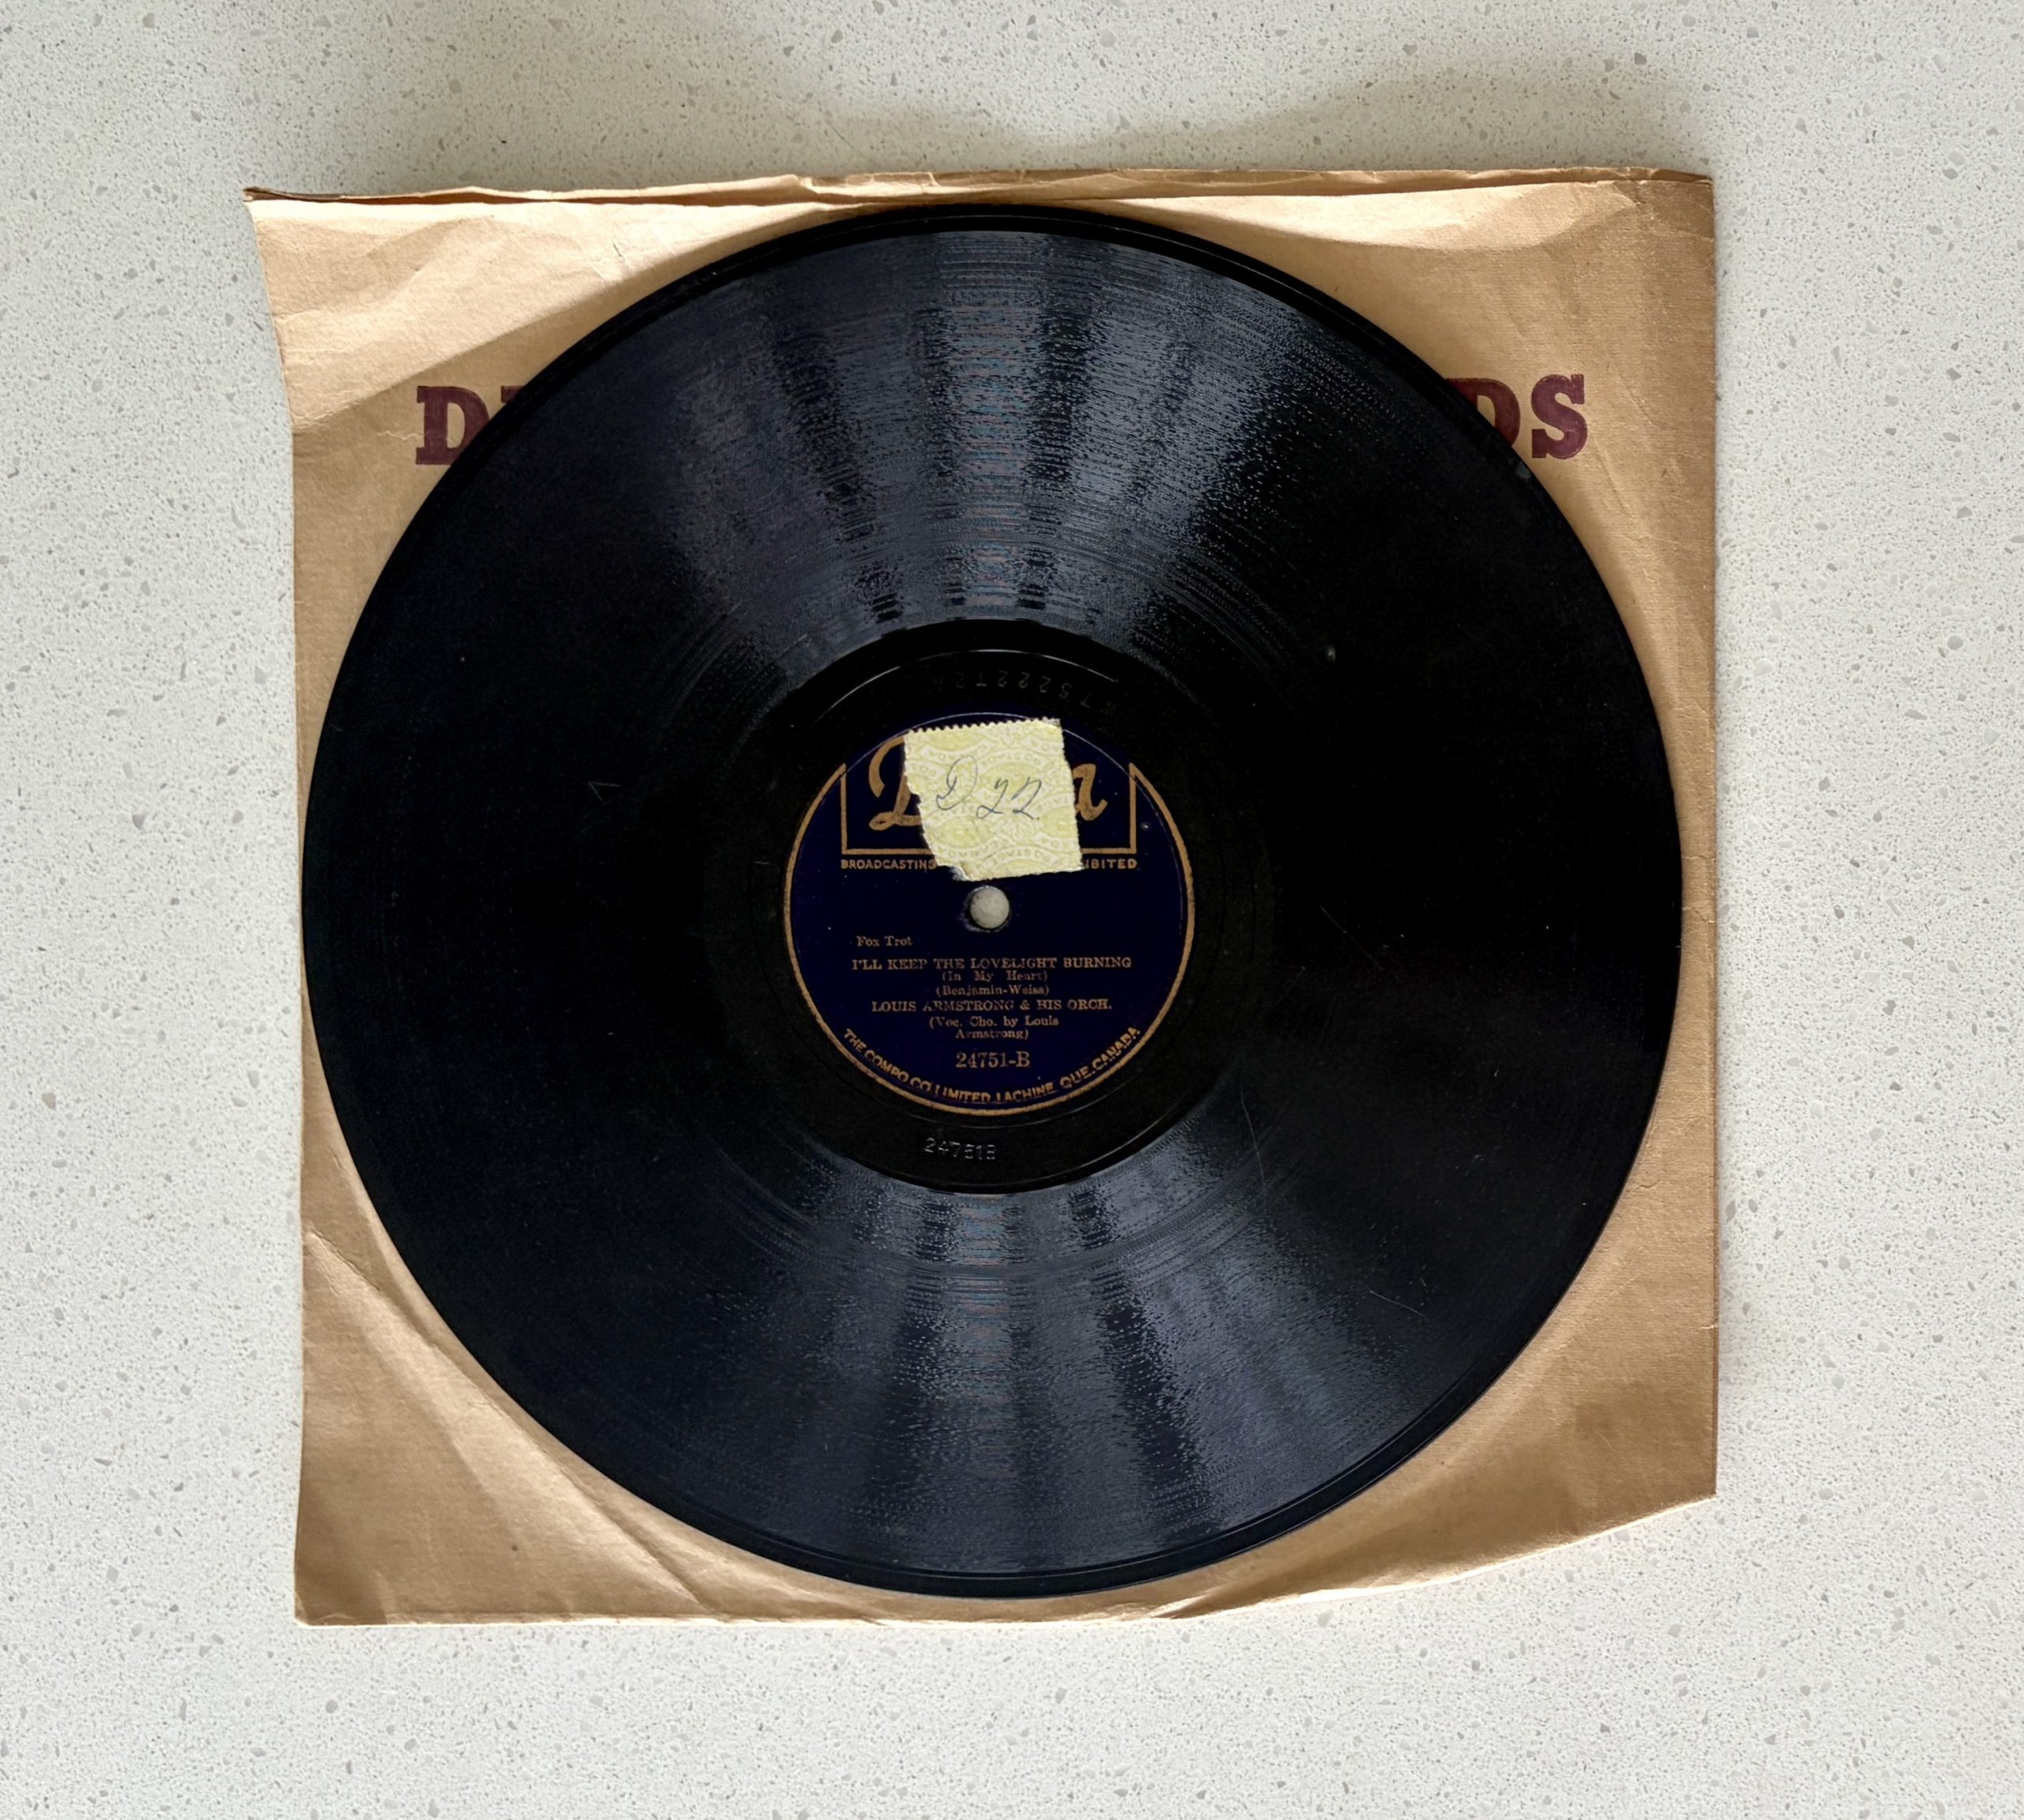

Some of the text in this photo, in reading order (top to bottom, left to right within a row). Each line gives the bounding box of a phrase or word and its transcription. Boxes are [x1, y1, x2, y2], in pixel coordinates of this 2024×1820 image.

[840, 858, 1138, 870] BROADCASTING IBITED
[856, 935, 912, 947] Fox Trot
[852, 957, 1132, 971] I'LL KEEP THE LOVELIGHT BURNING
[942, 969, 1048, 983] (In My Heart)
[871, 998, 1112, 1013] LOUIS ARMSTRONG & HIS ORCH.
[1003, 1015, 1019, 1029] by
[1024, 1014, 1059, 1027] Louis
[954, 1029, 1029, 1041] Armstrong)
[844, 1028, 867, 1053] THE
[864, 1049, 910, 1083] COMPO
[954, 1050, 1031, 1069] 24751-B
